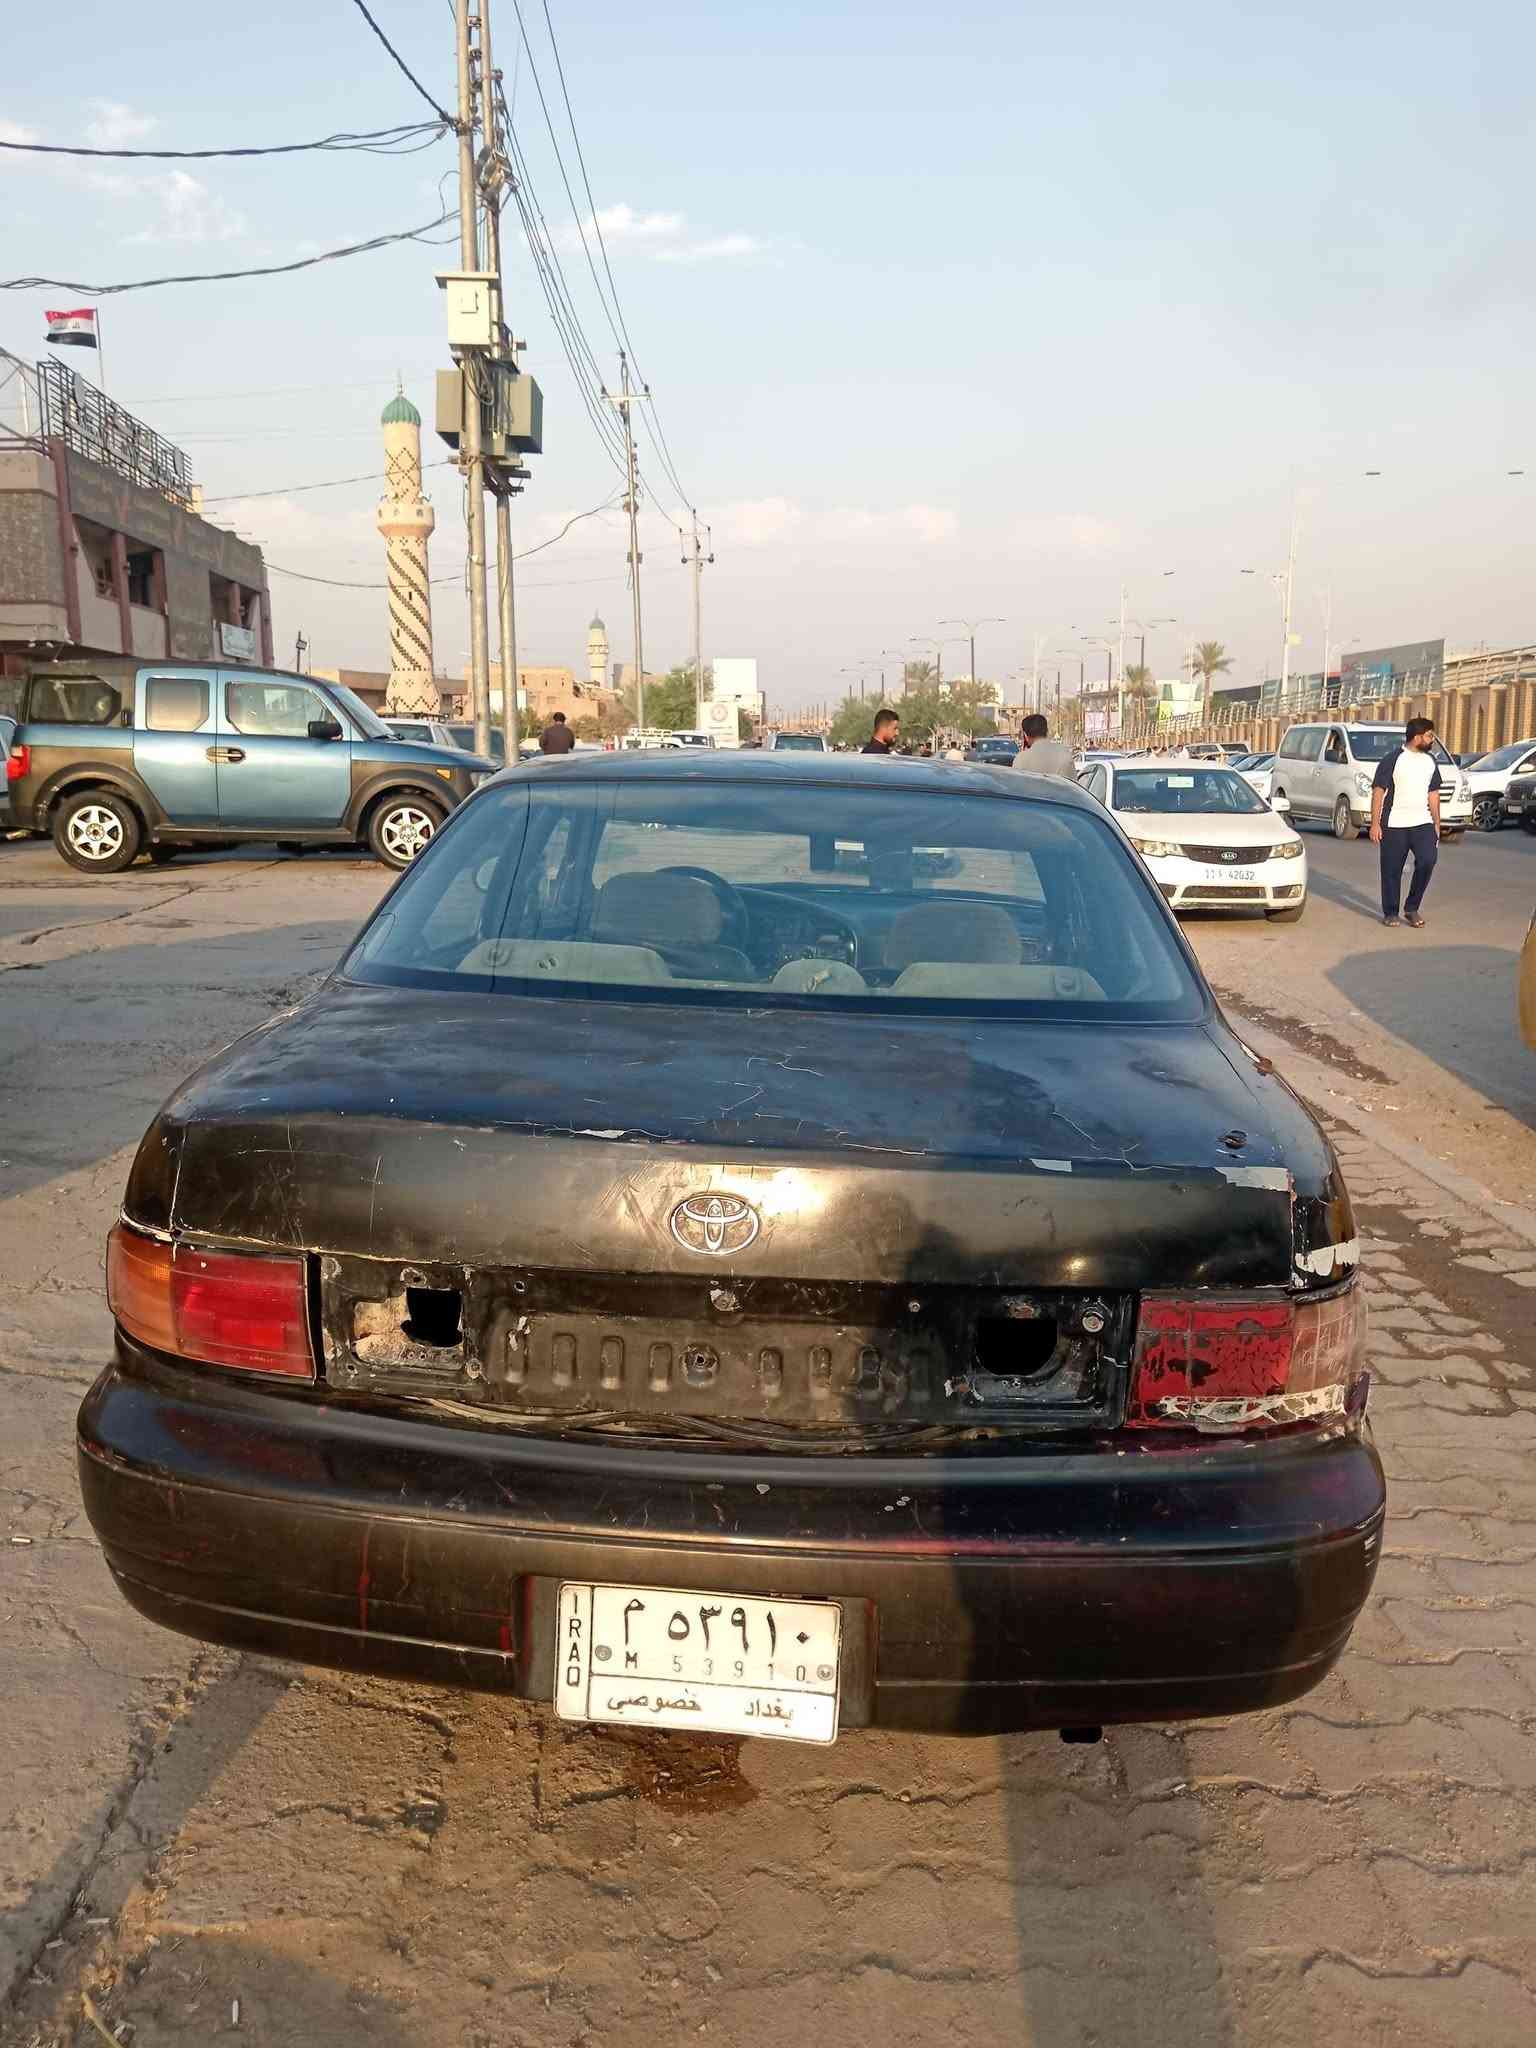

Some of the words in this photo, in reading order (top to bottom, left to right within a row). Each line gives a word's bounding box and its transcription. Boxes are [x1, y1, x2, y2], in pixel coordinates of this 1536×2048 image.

[566, 1593, 582, 1687] IRAQ
[624, 1598, 645, 1646] م
[667, 1605, 810, 1657] ٥٣٩١٠
[624, 1651, 638, 1669] M
[671, 1655, 807, 1682] 53910
[744, 1698, 795, 1728] بغداد
